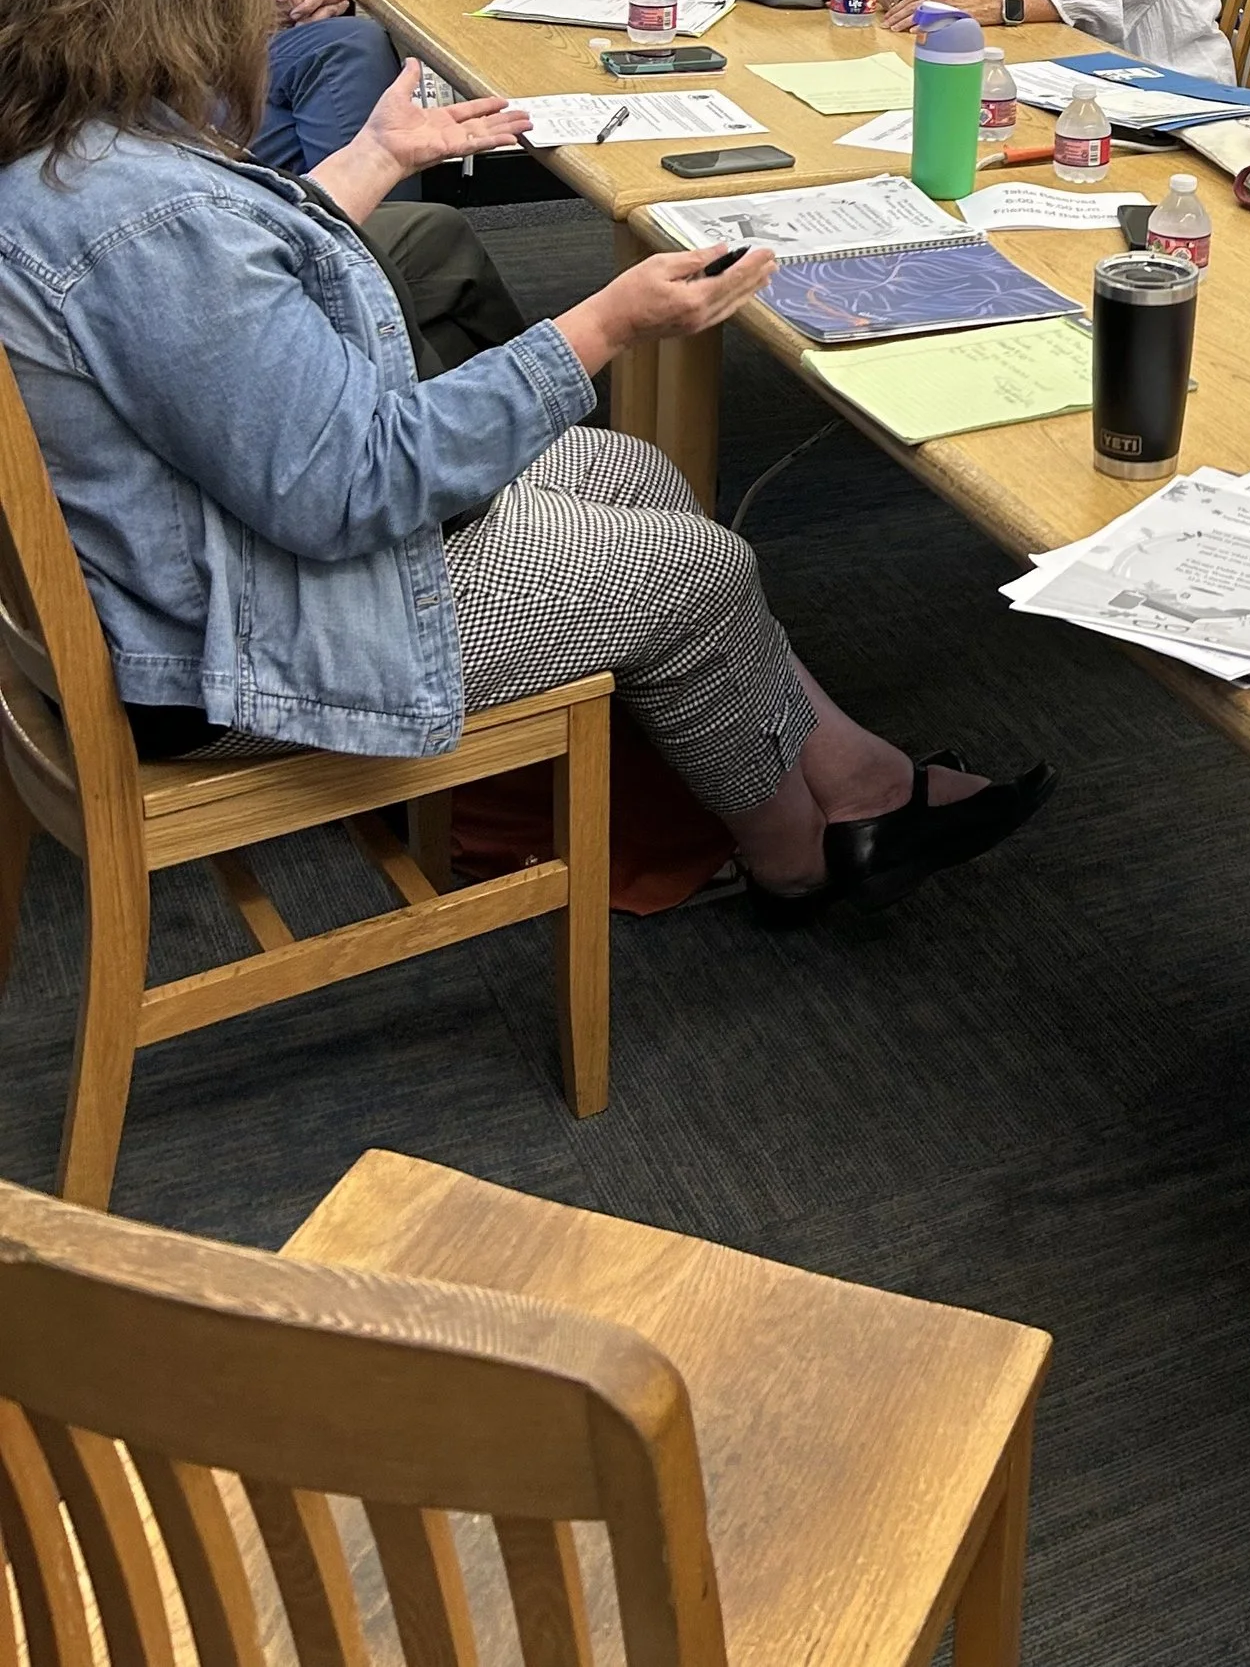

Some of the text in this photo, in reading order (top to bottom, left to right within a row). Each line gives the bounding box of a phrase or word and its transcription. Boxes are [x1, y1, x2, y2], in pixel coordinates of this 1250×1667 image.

[1039, 191, 1097, 205] Reserved
[993, 208, 1042, 216] Friends
[1058, 212, 1080, 220] the
[1103, 433, 1138, 452] YETI
